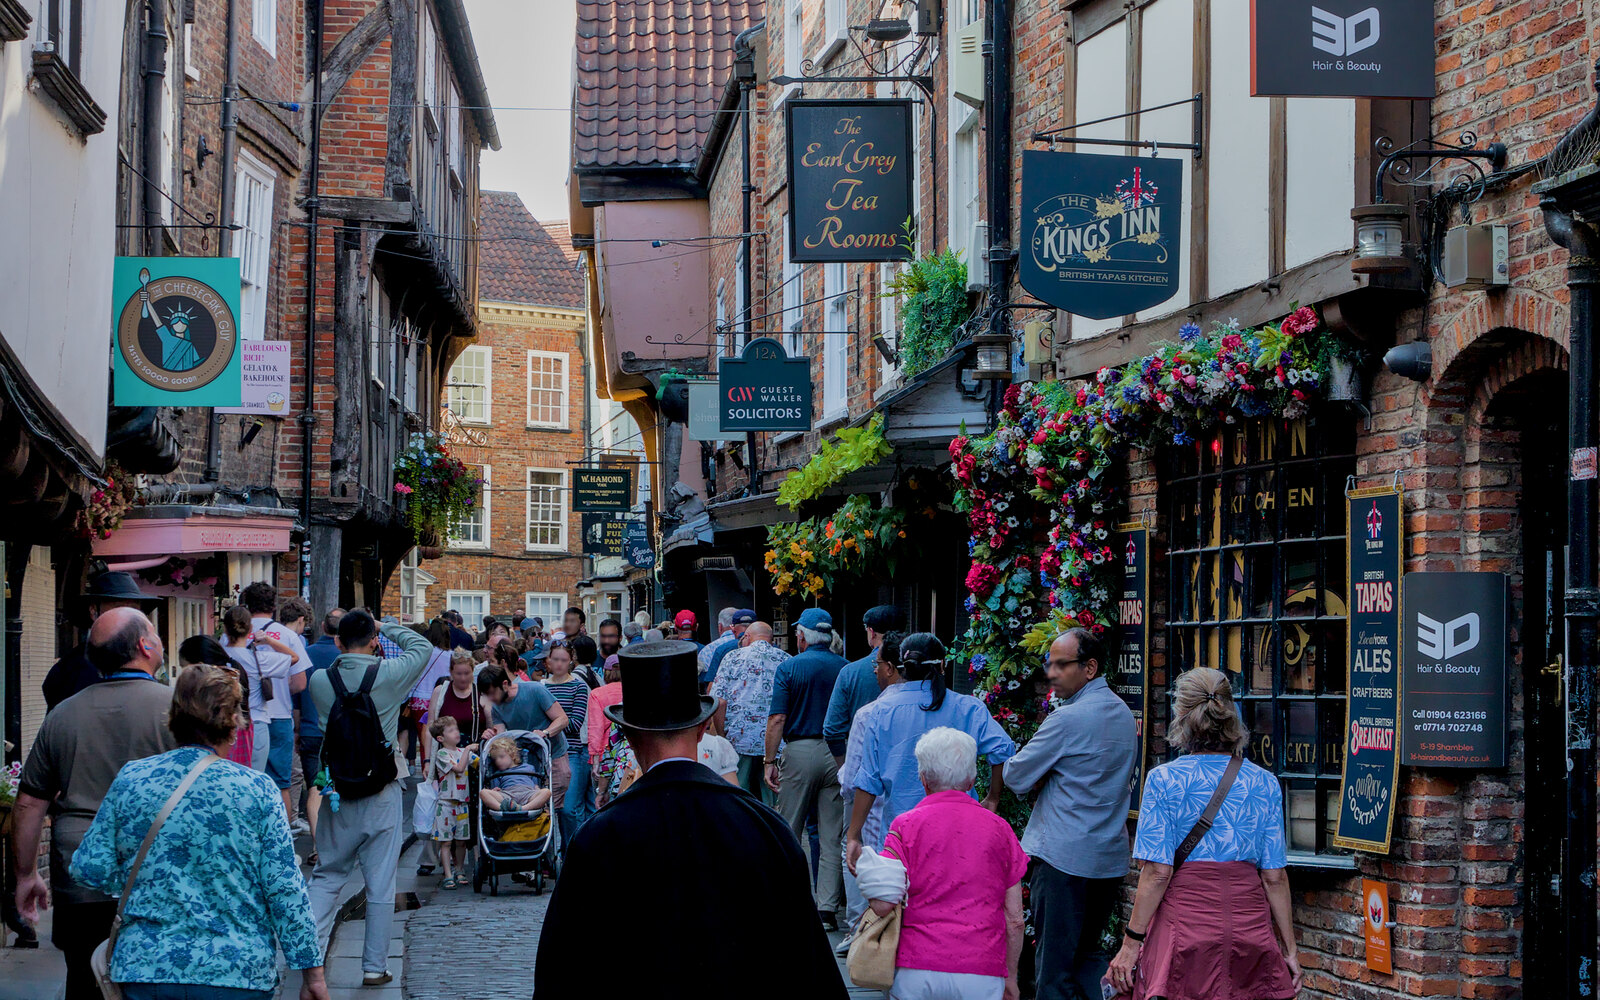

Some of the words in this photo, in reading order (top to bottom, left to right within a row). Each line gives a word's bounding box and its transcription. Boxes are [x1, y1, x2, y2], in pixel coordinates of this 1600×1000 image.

[1312, 60, 1333, 70] Hair
[1335, 60, 1344, 70] &
[1347, 60, 1381, 73] Beauty
[834, 116, 861, 134] The
[801, 139, 855, 167] Earl
[845, 142, 896, 175] Grey
[826, 179, 878, 210] Tea
[1058, 196, 1090, 208] THE
[804, 215, 897, 248] Rooms
[1043, 218, 1110, 263] KINGS
[1121, 206, 1160, 240] INN
[1059, 271, 1095, 279] BRITISH
[1097, 273, 1126, 281] TAPAS
[1128, 274, 1168, 283] KITCHEN
[151, 285, 163, 298] THE
[164, 283, 225, 318] CHEESECAKE
[218, 320, 230, 341] GUY
[243, 344, 287, 352] FABULOUSLY
[128, 344, 143, 367] TASTES
[243, 364, 271, 372] GELATO
[728, 408, 801, 419] SOLICITORS
[590, 475, 623, 483] HAMOND
[1231, 487, 1314, 514] KICHEN
[635, 555, 652, 565] Shop
[1364, 570, 1384, 580] BRITISH
[1355, 581, 1393, 613] TAPAS
[1118, 600, 1142, 625] TAPAS
[1374, 636, 1388, 645] YORK
[1117, 654, 1142, 674] ALES
[1354, 649, 1392, 673] ALES
[1417, 664, 1432, 673] Hair
[1434, 664, 1442, 673] &
[1445, 664, 1480, 675] Beauty
[1129, 685, 1142, 695] BEERS
[1352, 687, 1372, 698] CRAFT
[1372, 688, 1392, 698] BEERS
[1412, 710, 1425, 719] Call
[1426, 710, 1452, 719] 01904
[1453, 711, 1487, 720] 623166
[1359, 716, 1375, 726] ROYAL
[1375, 717, 1393, 727] BRITISH
[1422, 723, 1445, 731] 07714
[1447, 724, 1483, 732] 702748
[1351, 720, 1394, 755] BREAKFAST
[1437, 743, 1473, 751] Shambles
[1355, 773, 1381, 803] QUIRKY
[1348, 785, 1387, 825] COCKTAILS
